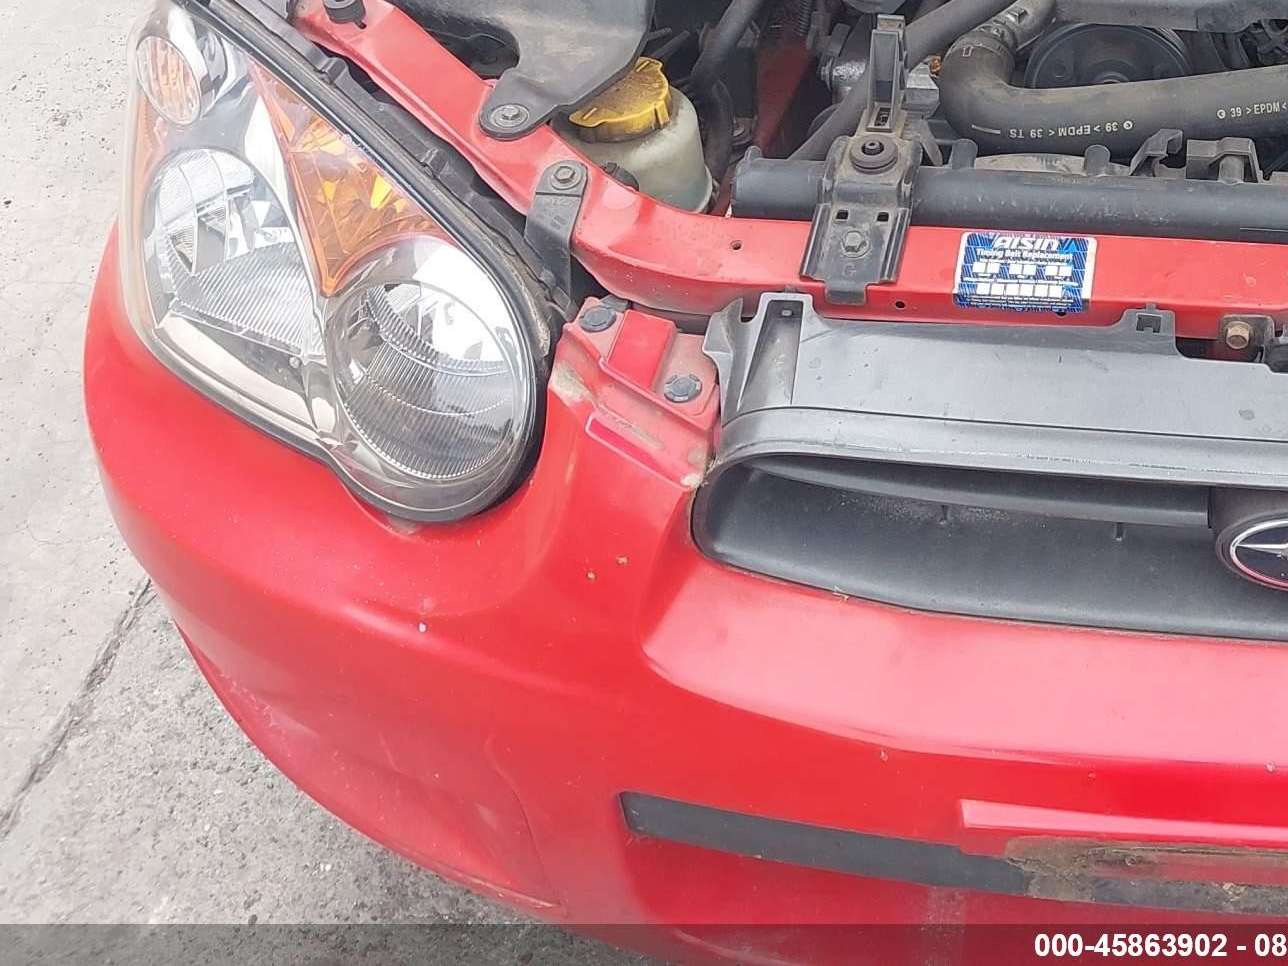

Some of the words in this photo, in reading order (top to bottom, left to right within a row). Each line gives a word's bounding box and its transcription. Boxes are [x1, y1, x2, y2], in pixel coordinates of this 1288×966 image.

[1230, 107, 1242, 118] 39
[1009, 128, 1025, 139] TS
[976, 247, 1004, 259] Timing
[1005, 249, 1020, 258] Belt
[1020, 251, 1073, 261] Replacement
